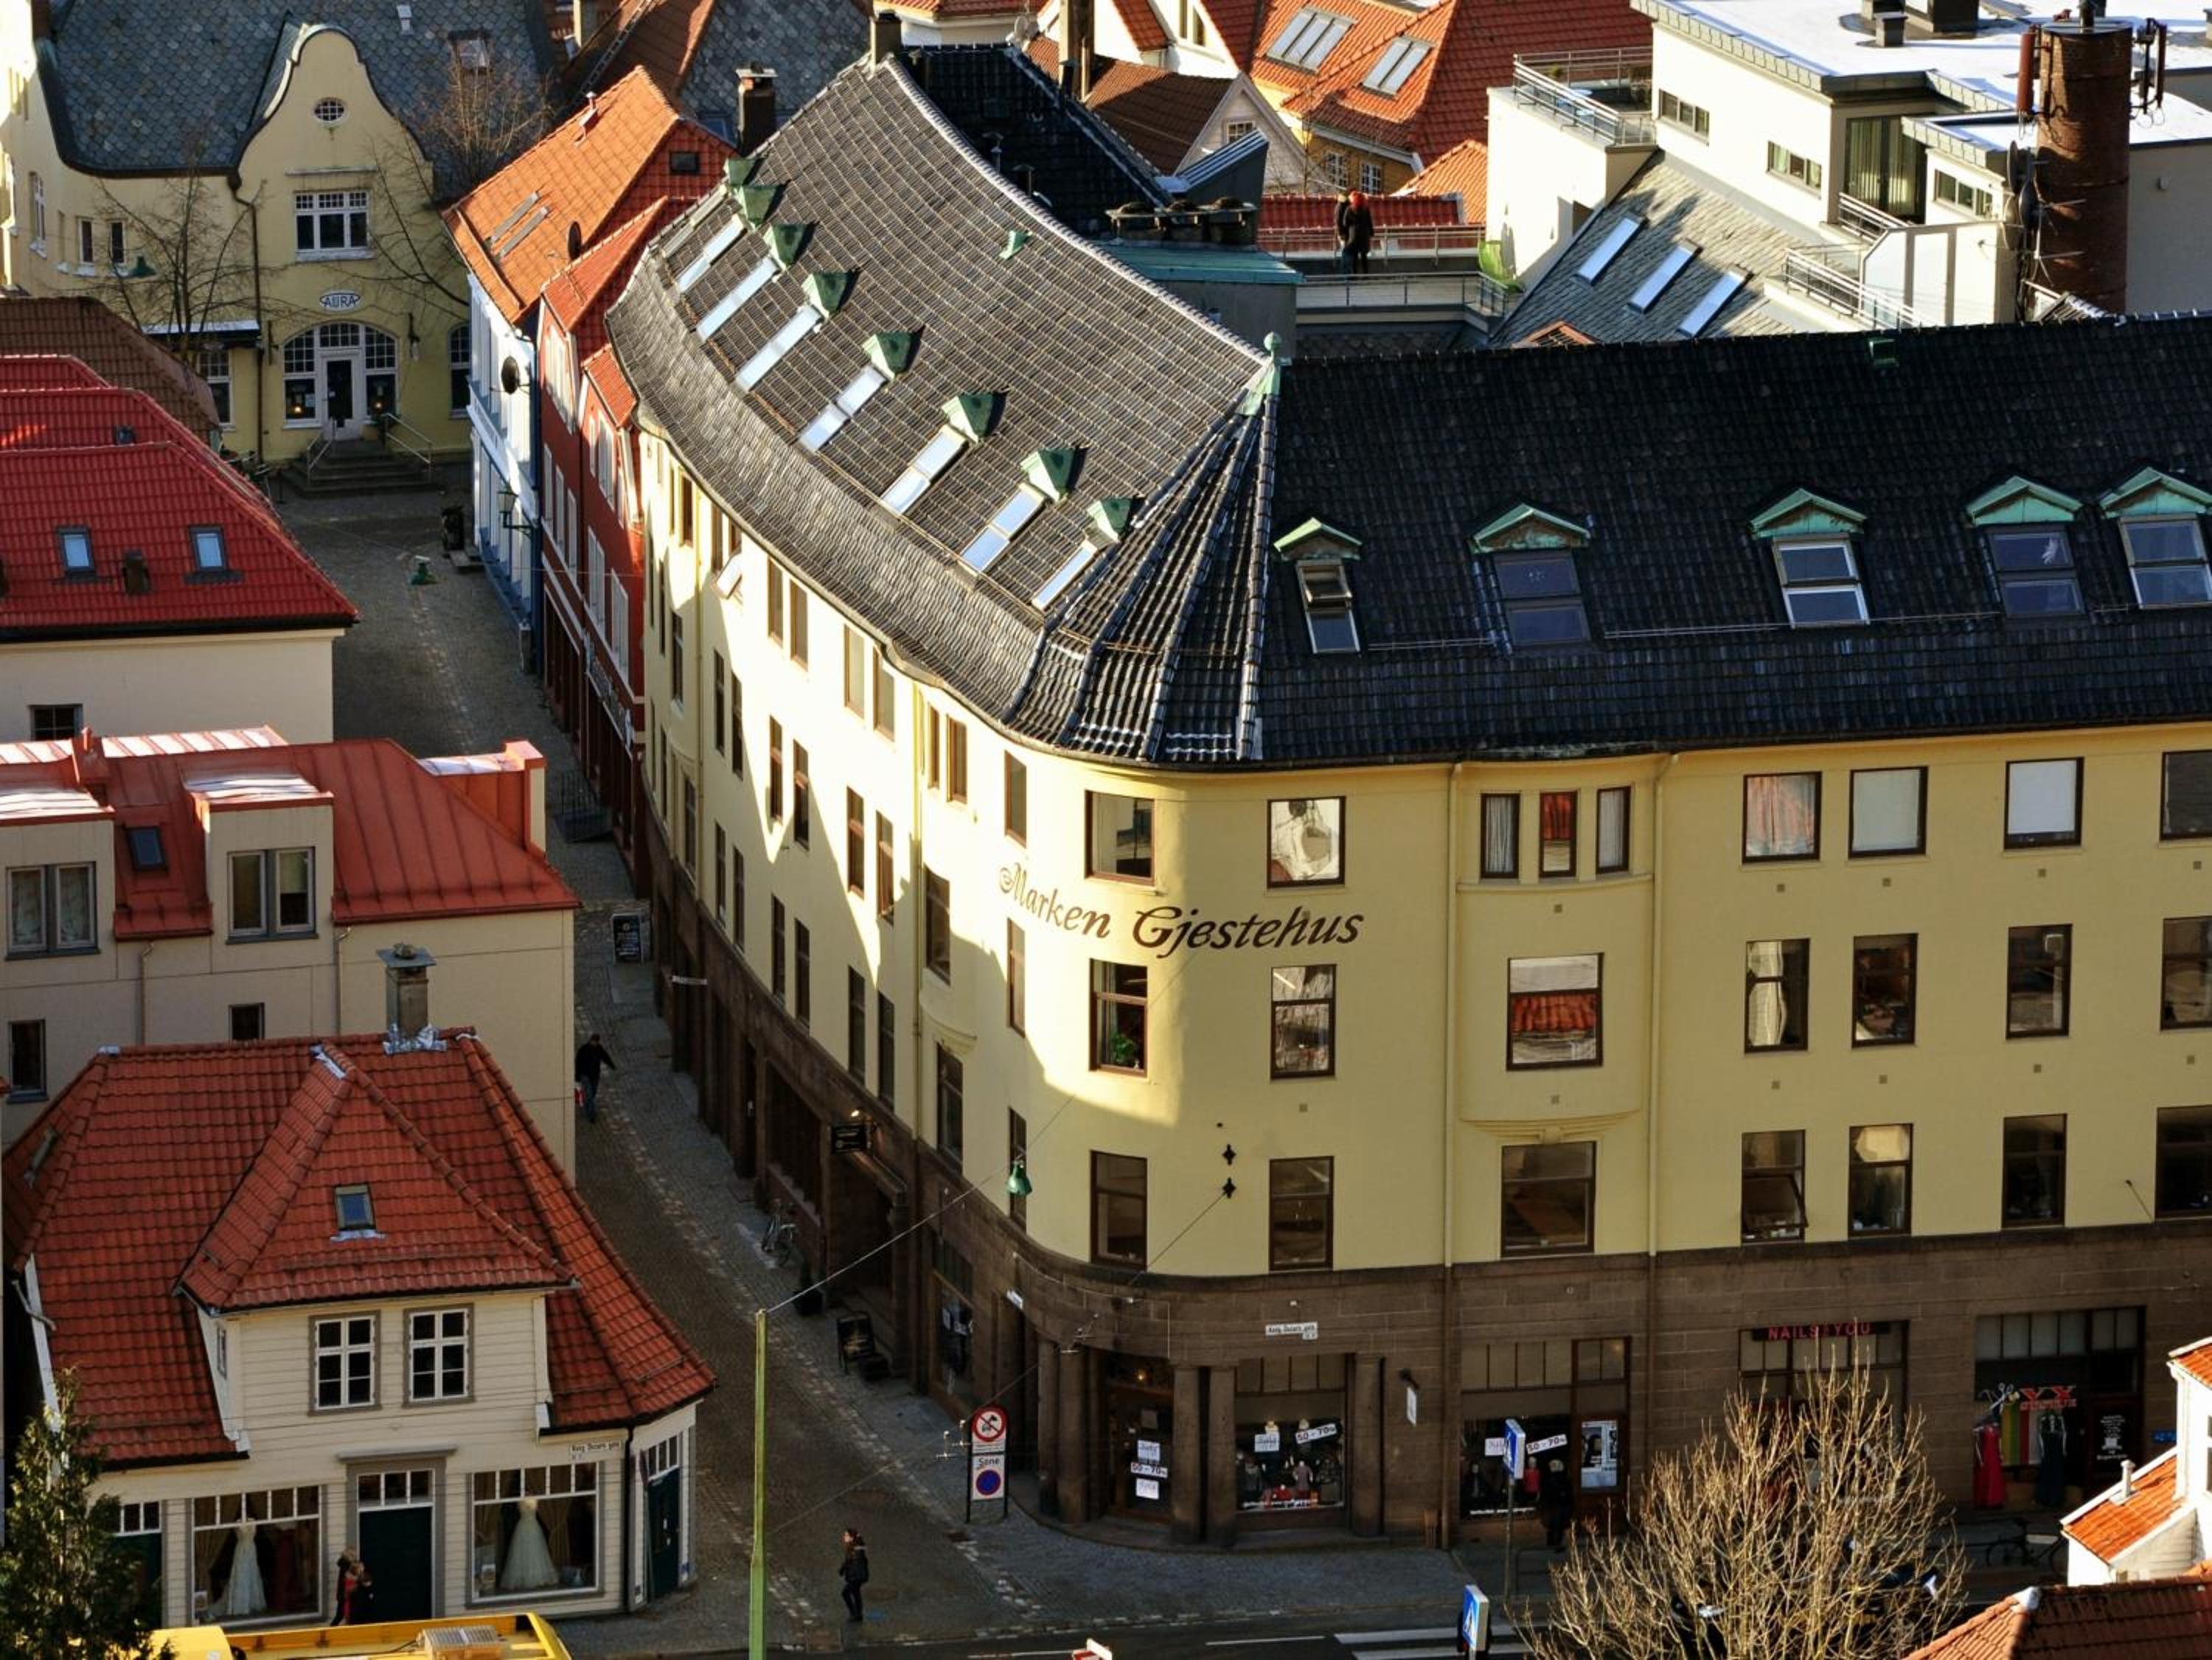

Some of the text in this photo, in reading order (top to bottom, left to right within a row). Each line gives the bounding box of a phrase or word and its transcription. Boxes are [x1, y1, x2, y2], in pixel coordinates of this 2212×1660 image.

[324, 296, 355, 307] AURA
[999, 861, 1365, 959] Marken Gjestehus
[1769, 1325, 1819, 1339] NAILS
